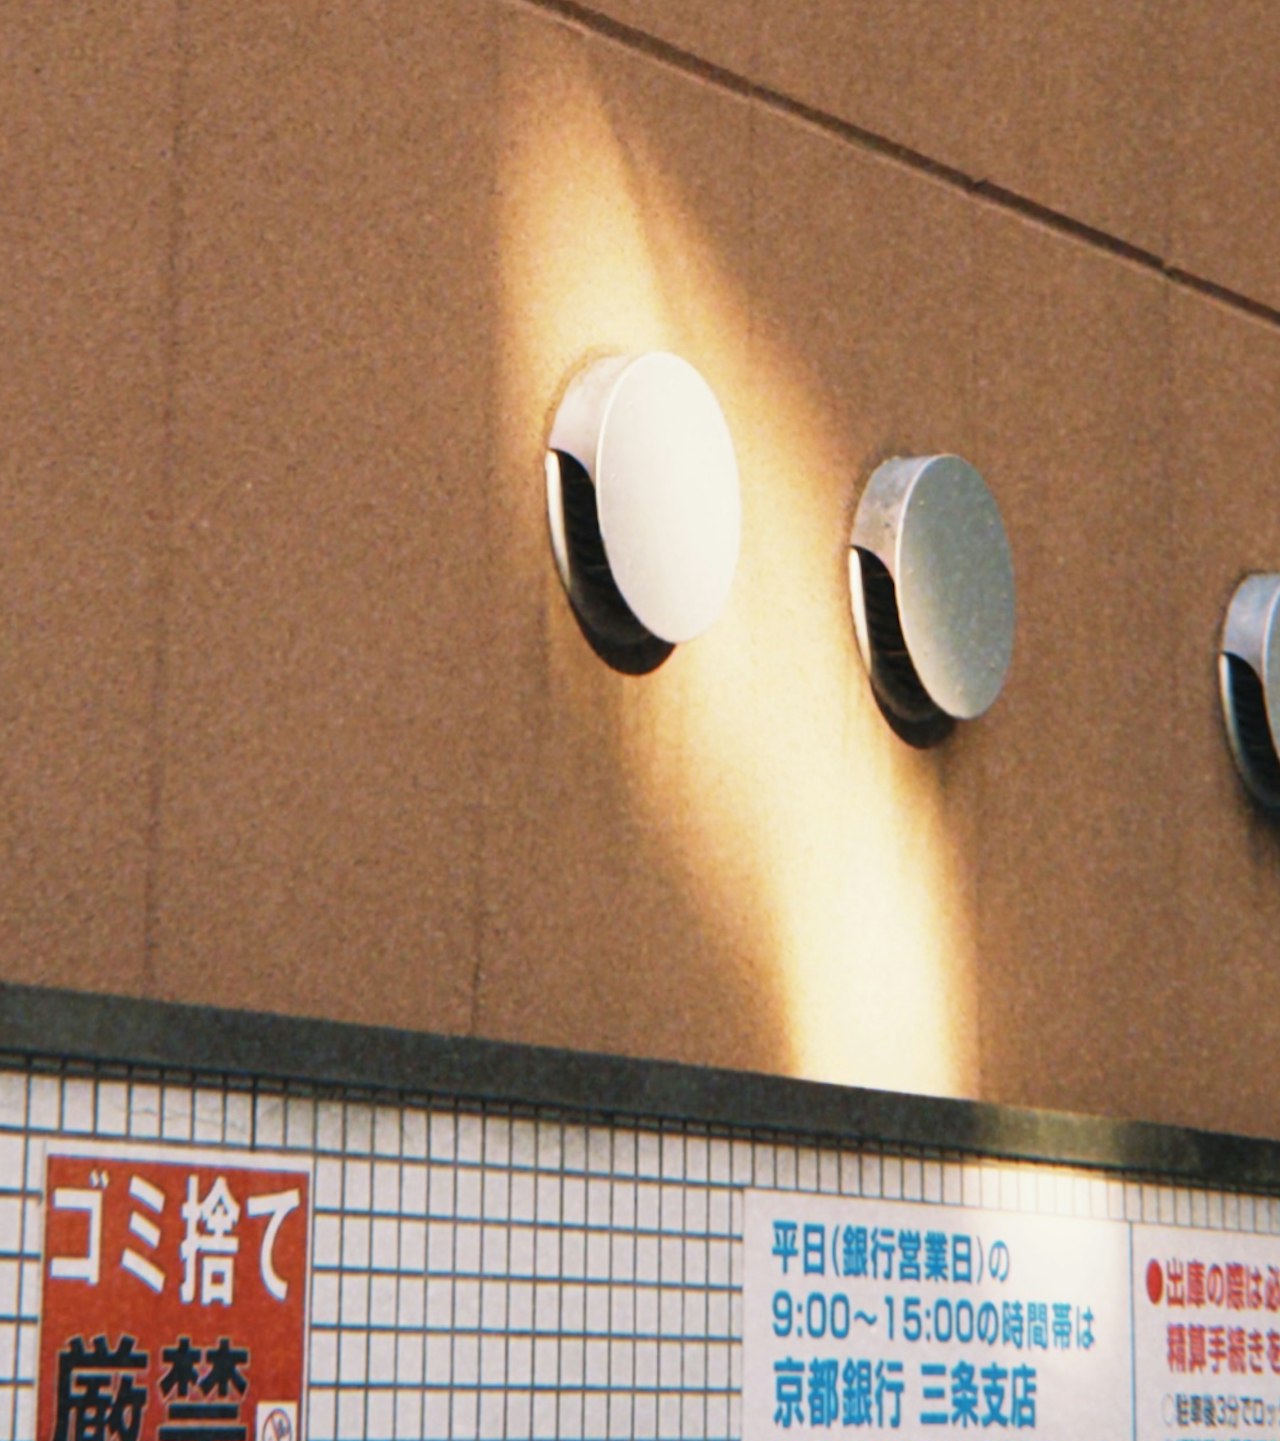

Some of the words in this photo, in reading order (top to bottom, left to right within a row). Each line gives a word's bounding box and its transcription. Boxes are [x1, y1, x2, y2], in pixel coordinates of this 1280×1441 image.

[49, 1169, 301, 1305] ゴミ捨て
[772, 1220, 1011, 1284] 平日(銀行営業日)の
[773, 1356, 904, 1429] 京都銀行
[920, 1361, 1037, 1429] 三条支店
